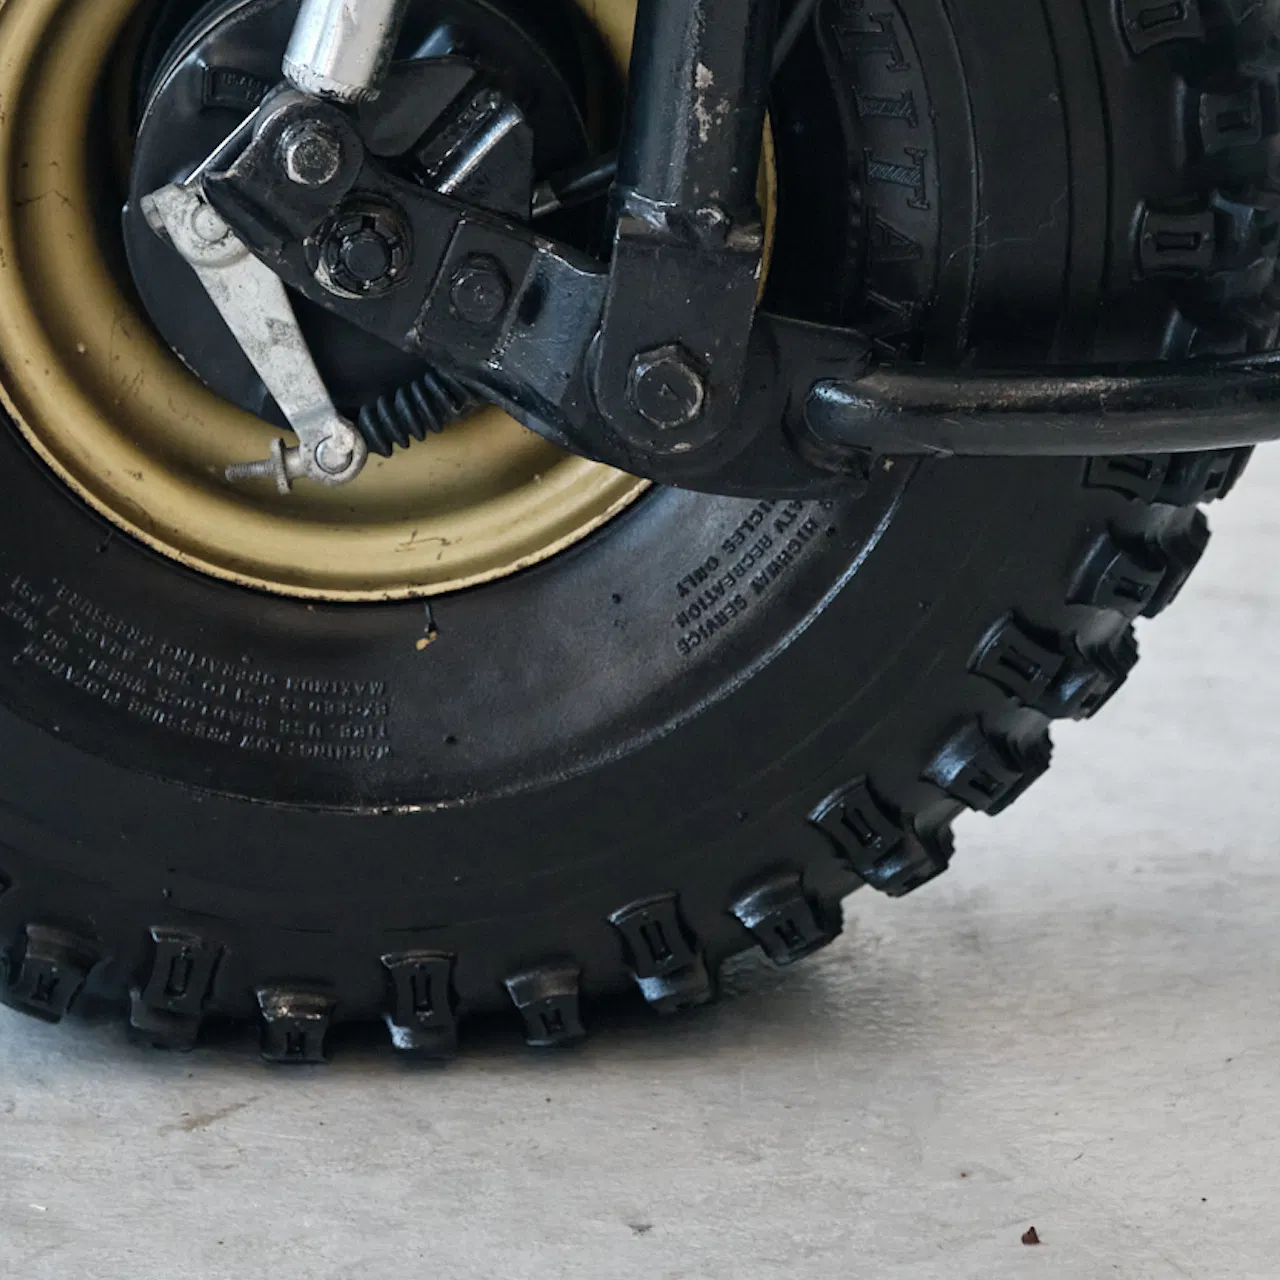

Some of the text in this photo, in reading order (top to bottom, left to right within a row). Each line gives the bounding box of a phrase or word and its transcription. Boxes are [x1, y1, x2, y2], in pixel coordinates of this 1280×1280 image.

[674, 535, 773, 629] RECREATION
[676, 555, 720, 599] ONLY
[676, 517, 820, 657] HIGHWAY SERVICE
[283, 674, 385, 697] MAXIMUM
[238, 732, 282, 755] LOW
